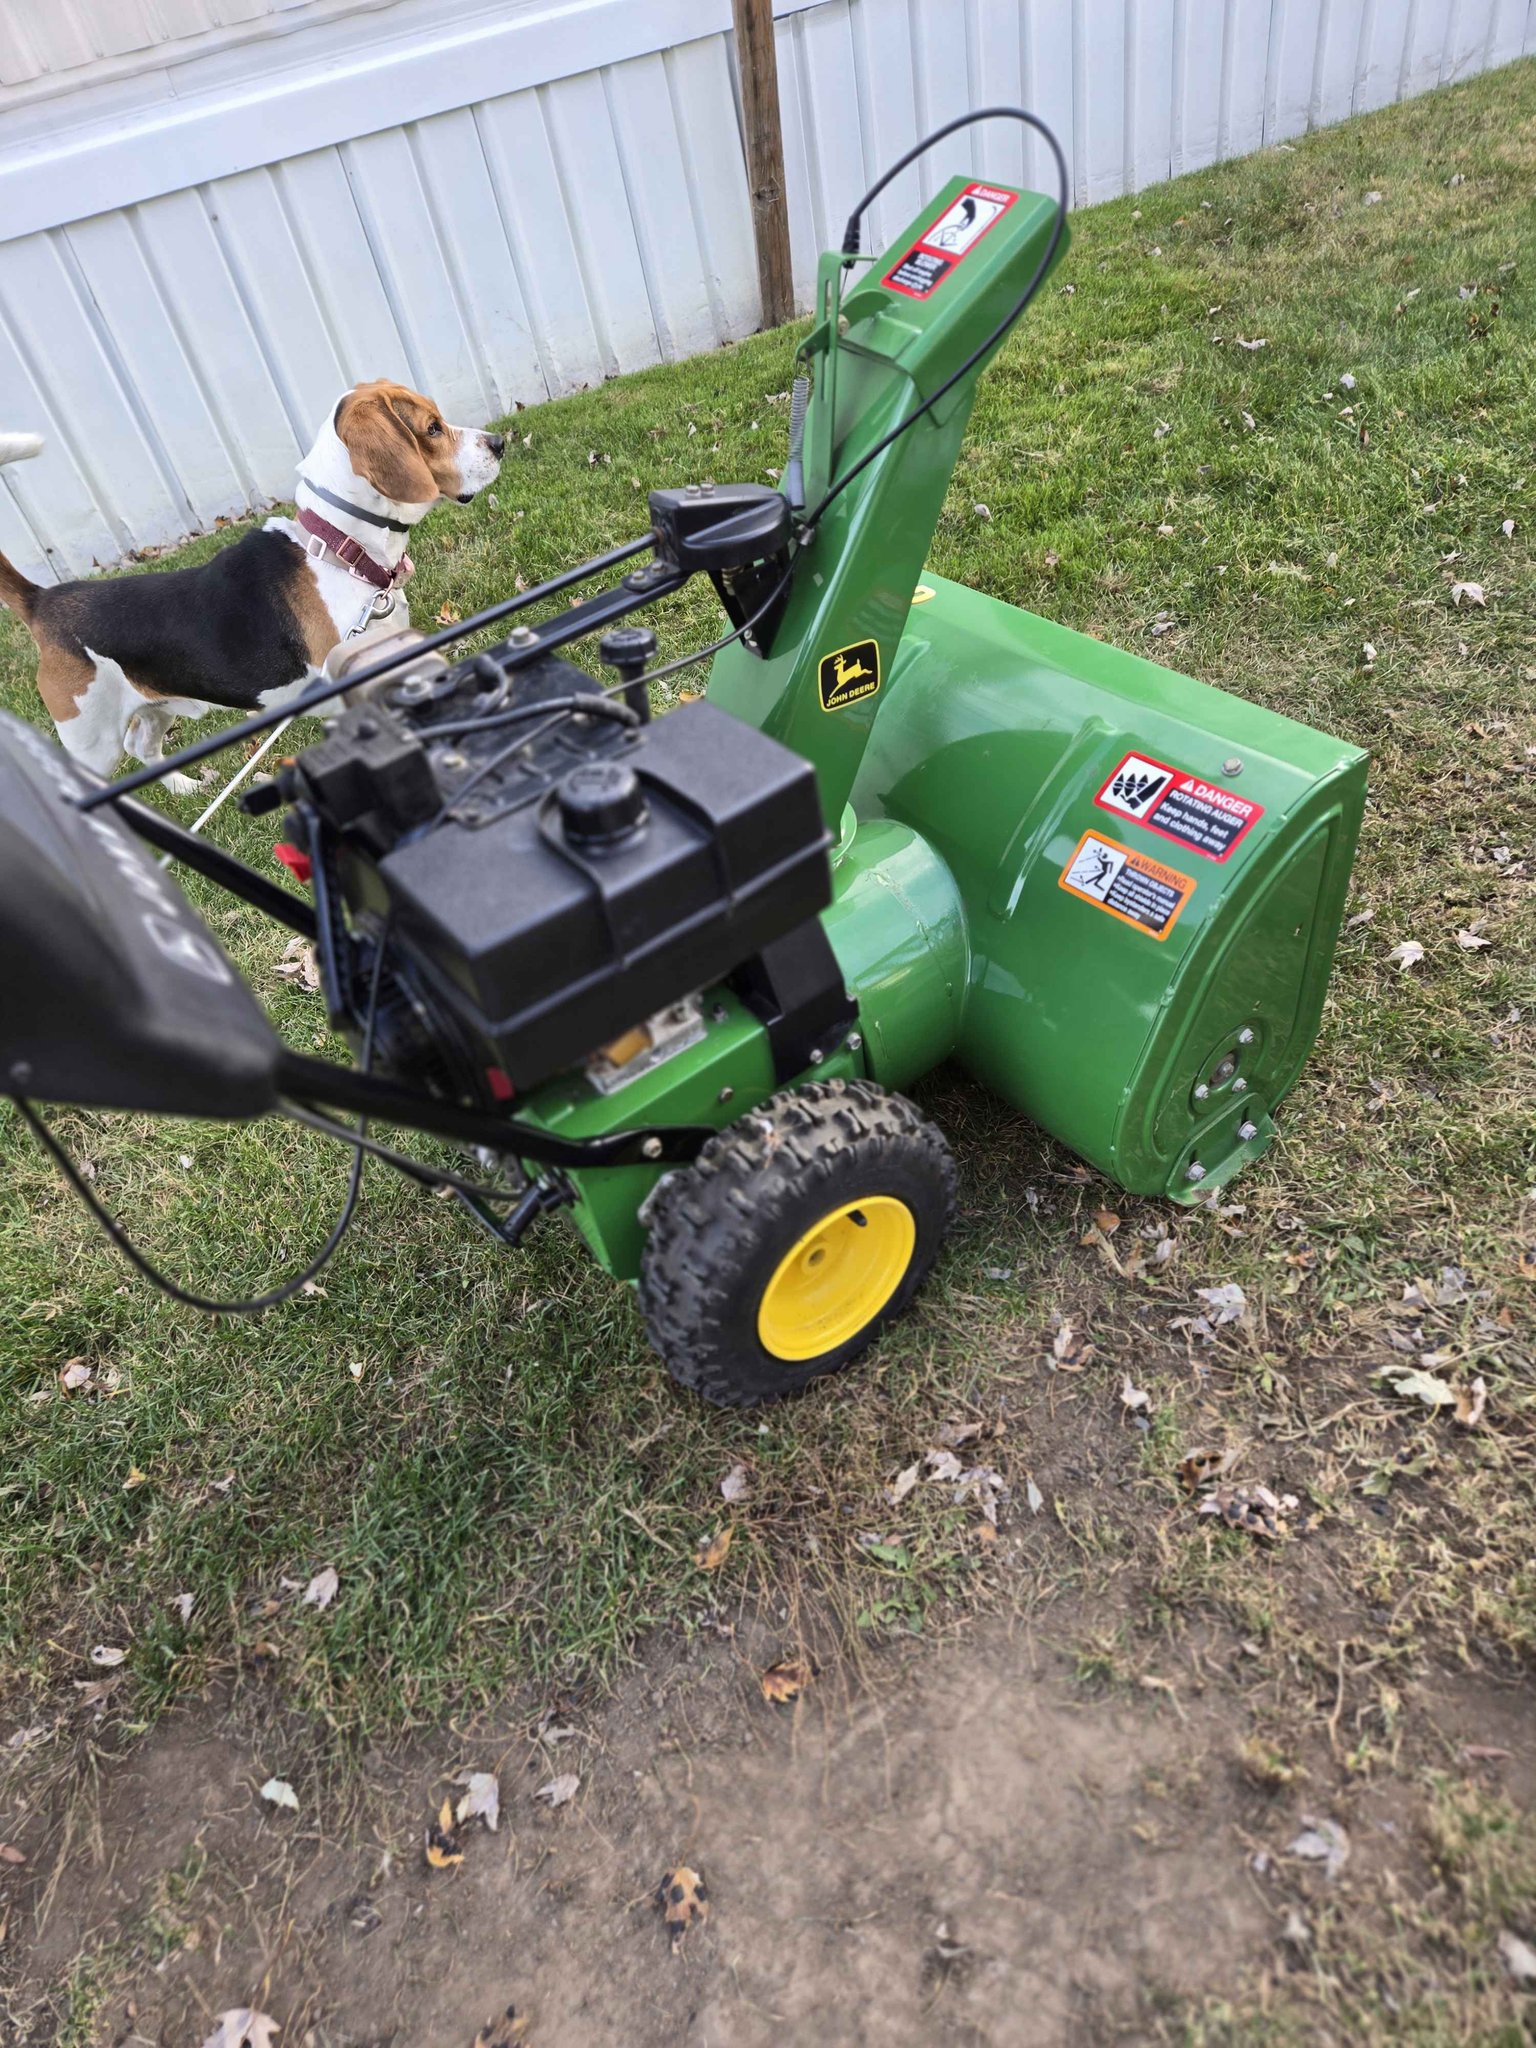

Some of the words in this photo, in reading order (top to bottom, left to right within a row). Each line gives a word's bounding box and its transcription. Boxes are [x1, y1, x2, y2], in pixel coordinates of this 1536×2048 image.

[826, 692, 848, 708] JOHN
[848, 681, 876, 698] DEERE
[1169, 789, 1214, 814] ROTATING
[1212, 807, 1245, 829] AUGER
[1194, 783, 1253, 818] DANGER
[1152, 812, 1170, 825] and
[1169, 819, 1203, 842] clothing
[1202, 835, 1227, 852] away
[1159, 802, 1182, 819] Keep
[1182, 811, 1209, 832] hands,
[1209, 824, 1230, 839] feet
[1140, 858, 1188, 890] WARNING
